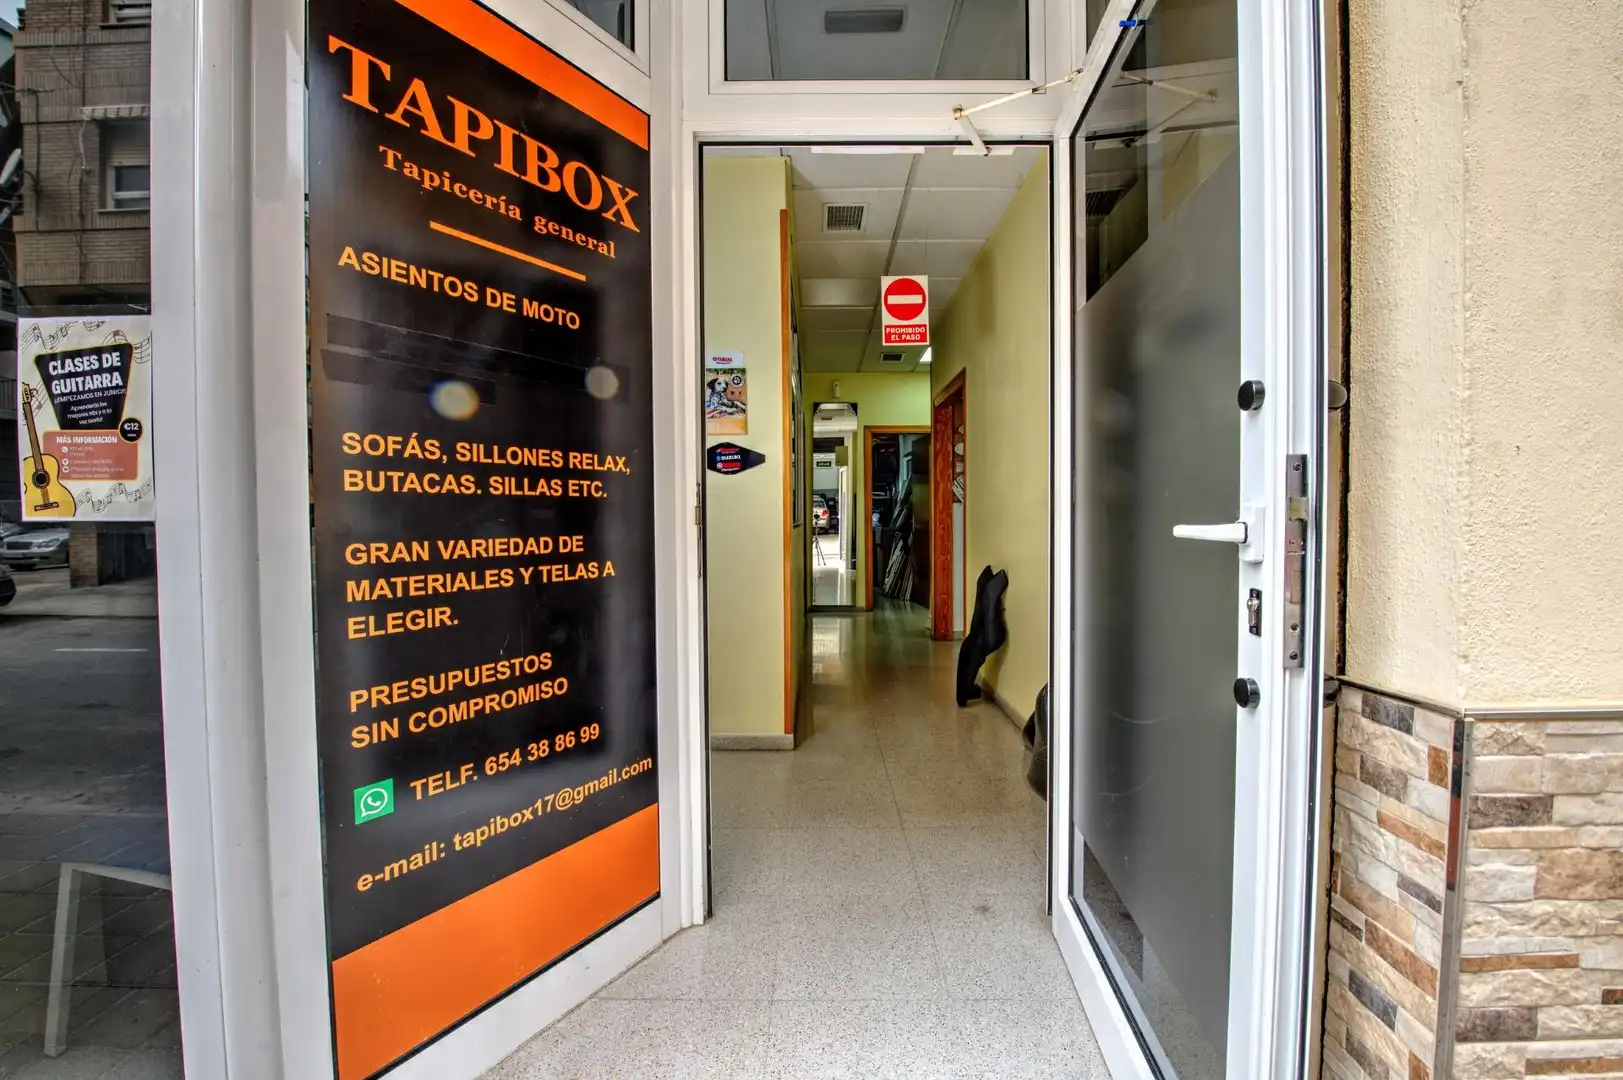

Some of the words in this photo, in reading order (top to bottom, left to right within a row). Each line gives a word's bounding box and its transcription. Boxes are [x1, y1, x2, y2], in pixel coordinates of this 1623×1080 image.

[328, 35, 640, 232] TAPIBOX
[379, 145, 522, 221] Tapicería
[534, 215, 616, 258] general
[338, 246, 479, 302] ASIENTOS
[486, 287, 516, 313] DE
[522, 298, 580, 330] MOTO
[48, 354, 100, 376] CLASES
[101, 351, 121, 368] DE
[51, 371, 123, 395] GUITARRA
[56, 434, 72, 444] MÁS
[72, 434, 118, 444] INFORMACIÓN
[123, 422, 139, 431] €12
[342, 432, 448, 463] SOFÁS,
[455, 442, 563, 468] SILLONES
[569, 452, 630, 475] RELAX,
[343, 469, 482, 494] BUTACAS.
[489, 476, 562, 496] SILLAS
[568, 480, 607, 498] ETC.
[345, 541, 429, 565] GRAN
[437, 536, 553, 560] VARIEDAD
[558, 535, 584, 553] DE
[346, 568, 514, 602] MATERIALES
[519, 567, 533, 585] Y
[538, 562, 599, 583] TELAS
[602, 561, 616, 577] A
[348, 607, 459, 639] ELEGIR.
[350, 652, 552, 712] PRESUPUESTOS
[351, 718, 399, 748] SIN
[408, 677, 568, 733] COMPROMISO
[410, 763, 477, 800] TELF.
[485, 748, 522, 776] 654
[527, 740, 550, 761] 38
[555, 730, 576, 752] 86
[580, 723, 600, 744] 99
[357, 841, 446, 892] e-mail:
[453, 757, 652, 851] tapibox17@gmail.com
